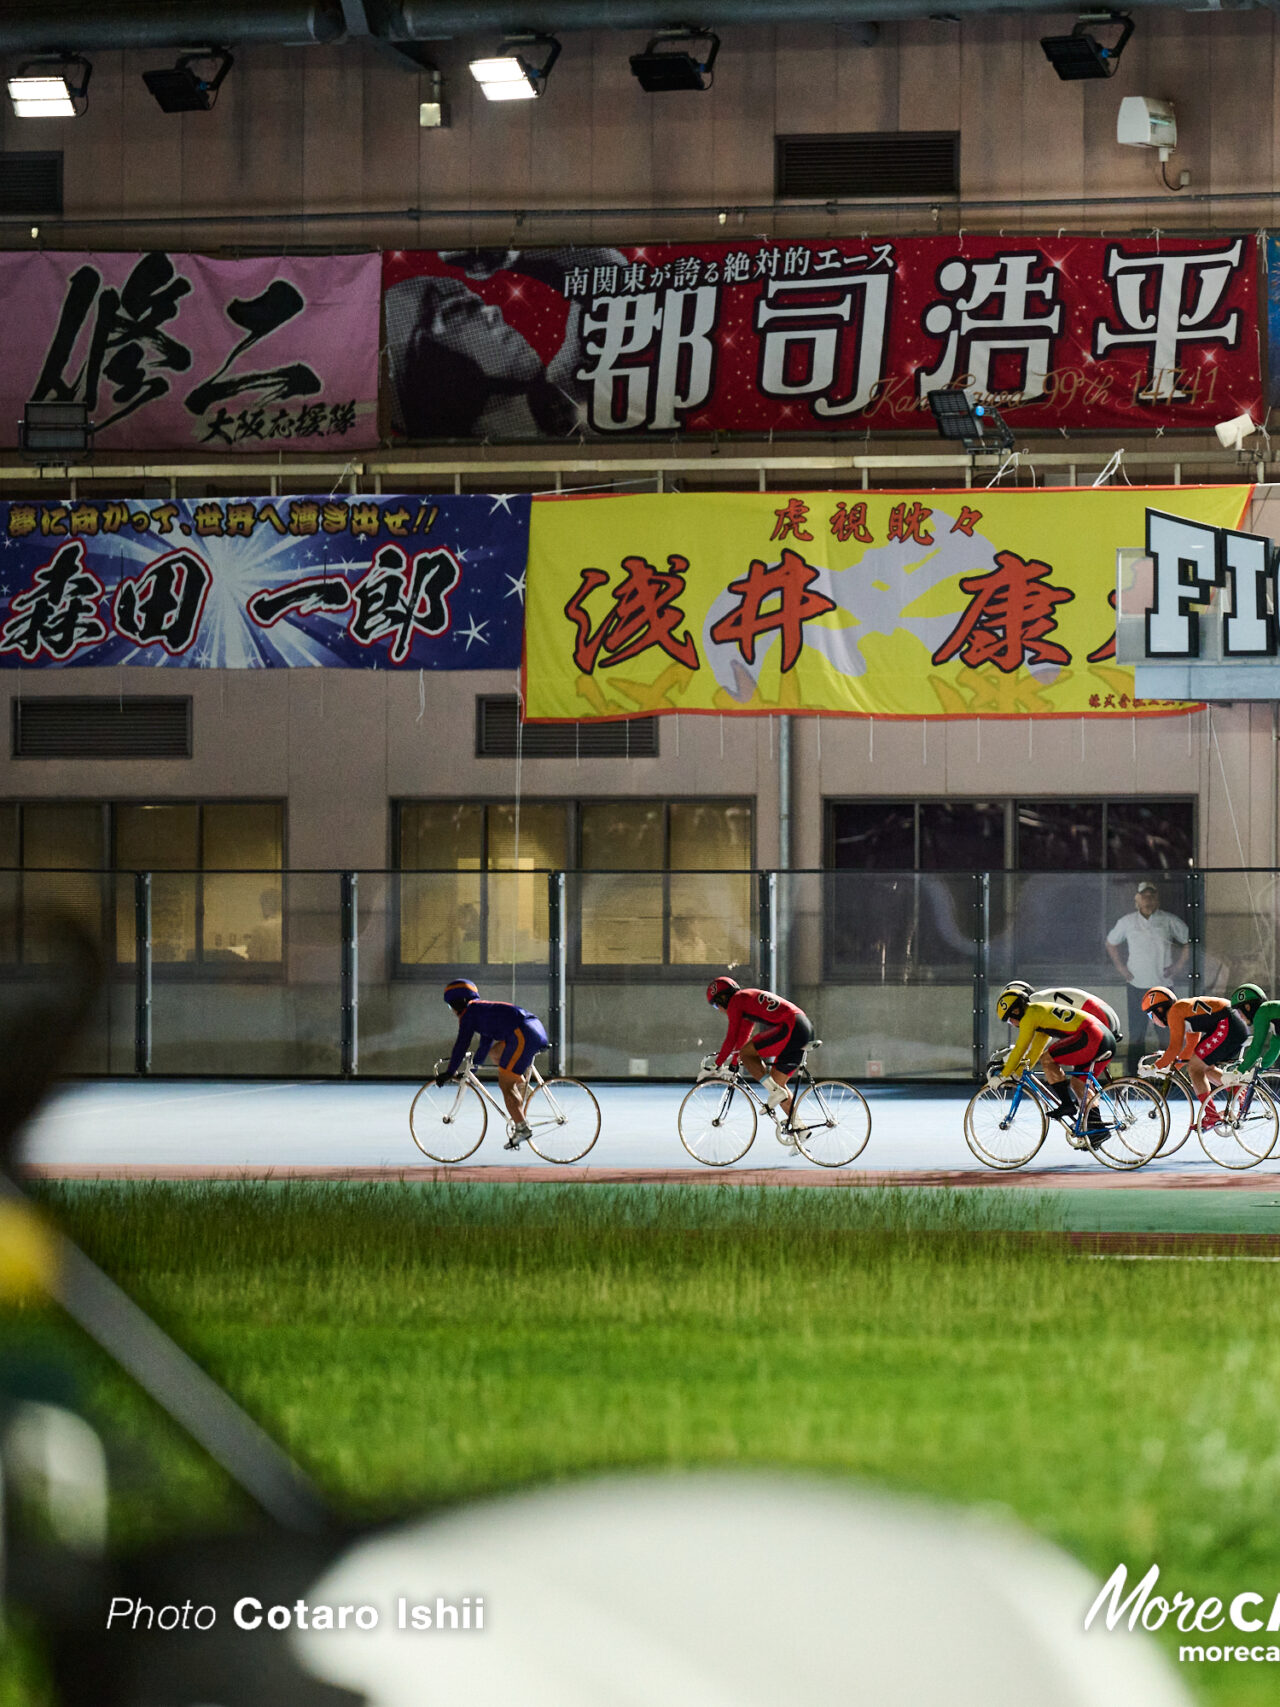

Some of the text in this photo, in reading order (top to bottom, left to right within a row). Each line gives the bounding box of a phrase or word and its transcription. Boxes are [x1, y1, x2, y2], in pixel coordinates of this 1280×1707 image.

[563, 242, 898, 298] 南関東が誇る絶対的エース
[577, 239, 1243, 432] 郡司浩平
[1115, 364, 1222, 408] 14741
[758, 992, 780, 1012] 3
[1237, 990, 1246, 1001] 6
[1000, 999, 1008, 1011] 5
[1192, 1000, 1212, 1015] 7
[1051, 1006, 1076, 1023] 5
